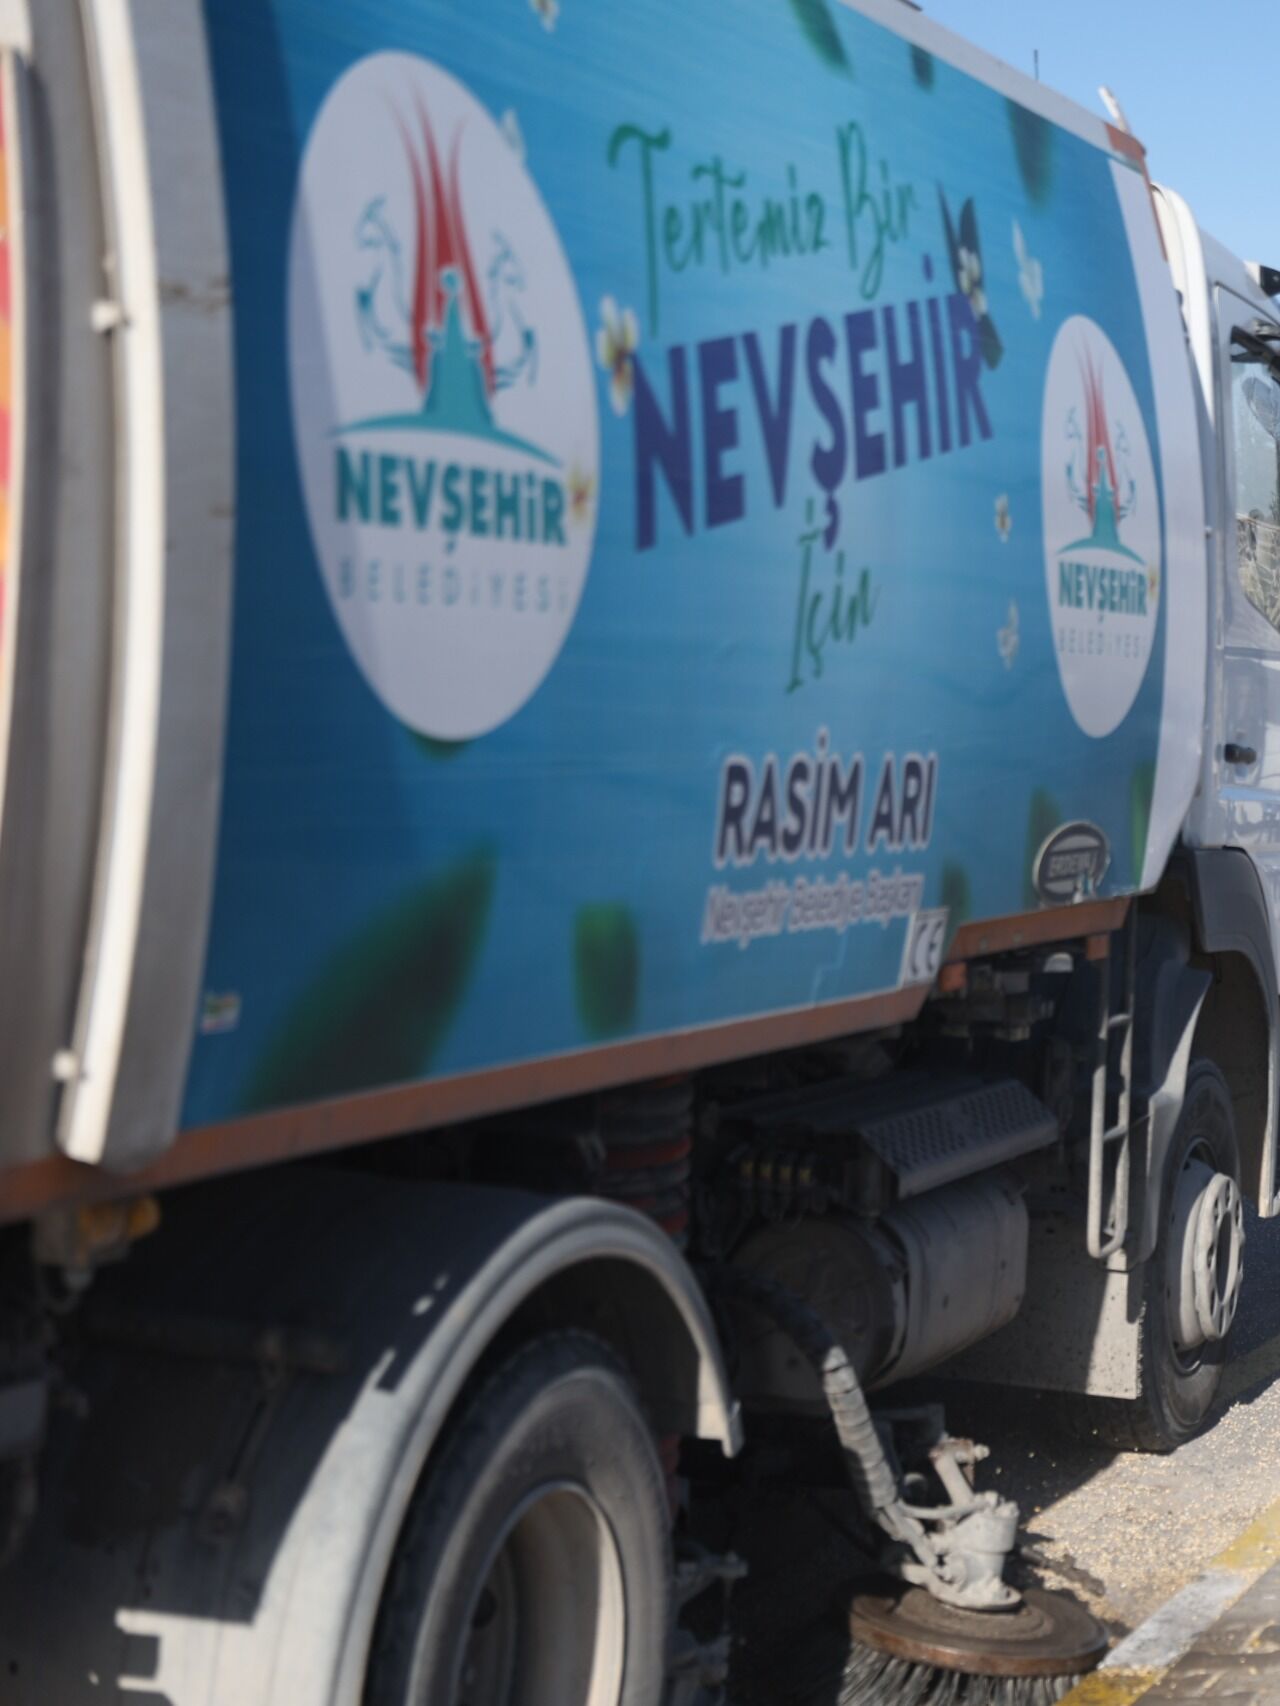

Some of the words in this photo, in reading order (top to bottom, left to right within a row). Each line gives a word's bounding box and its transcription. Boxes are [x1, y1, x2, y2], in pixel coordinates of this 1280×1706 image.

[608, 123, 828, 338] Tertemiz
[835, 120, 919, 300] Bir
[632, 253, 994, 554] NEVŞEHİR
[335, 441, 569, 556] NEVŞEHİR
[786, 497, 880, 695] İçin
[1058, 559, 1147, 624] NEVŞEHİR
[715, 729, 864, 866] RASİM
[867, 754, 937, 853] ARI
